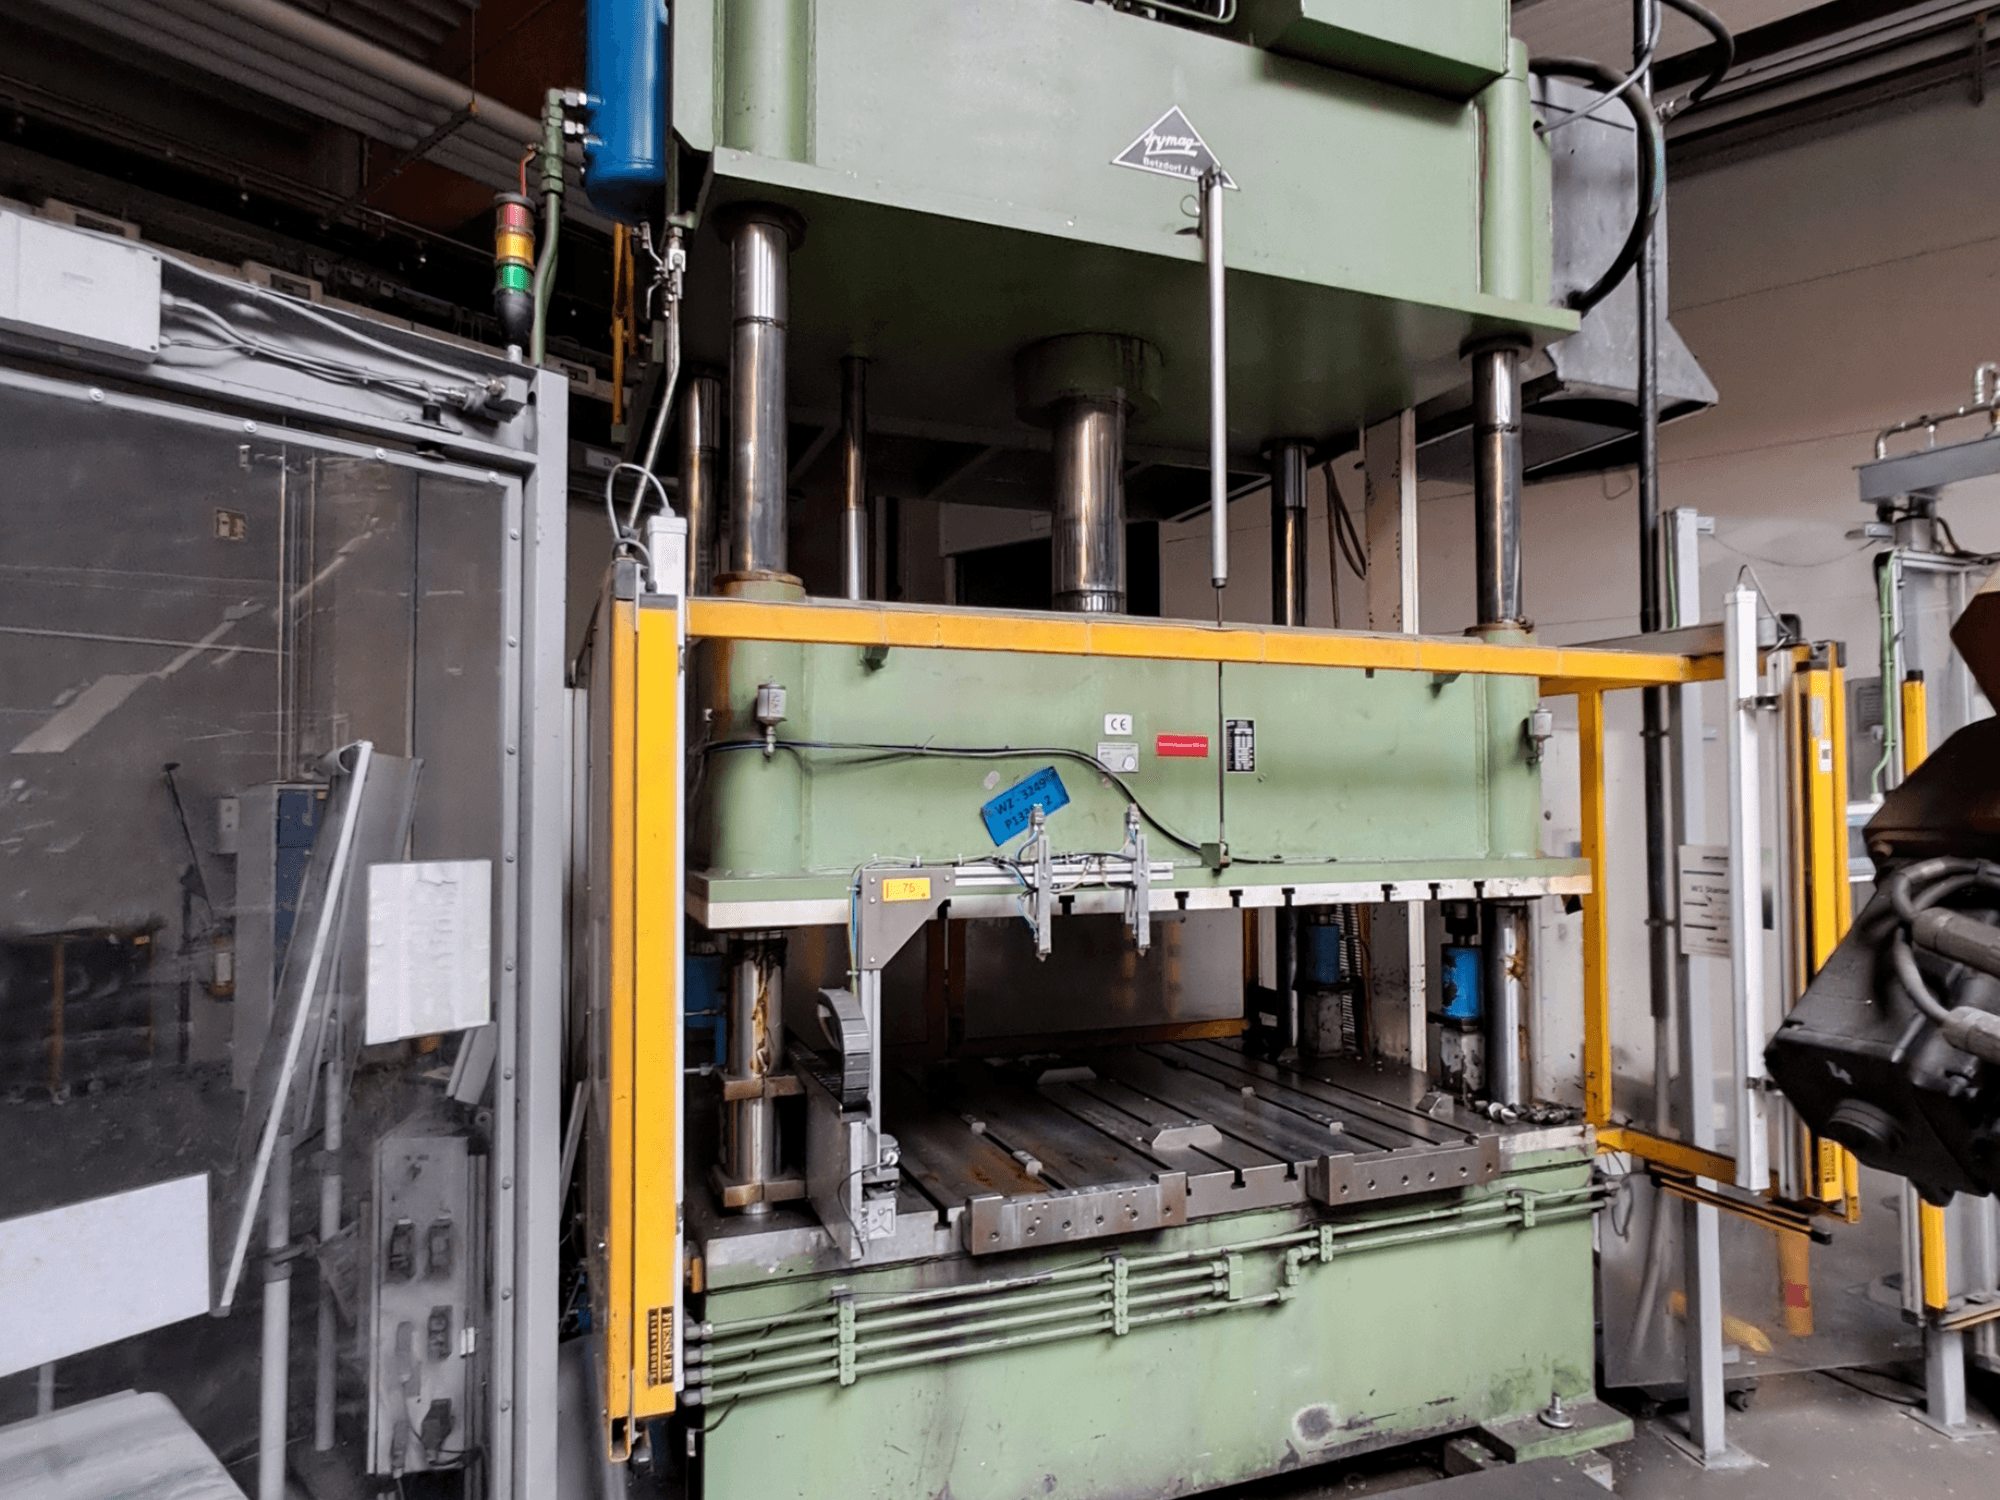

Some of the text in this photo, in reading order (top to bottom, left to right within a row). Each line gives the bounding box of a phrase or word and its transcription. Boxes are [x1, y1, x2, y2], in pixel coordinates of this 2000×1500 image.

[1110, 718, 1127, 731] CE
[994, 798, 1015, 815] WZ
[662, 1312, 673, 1377] FIESSLER
